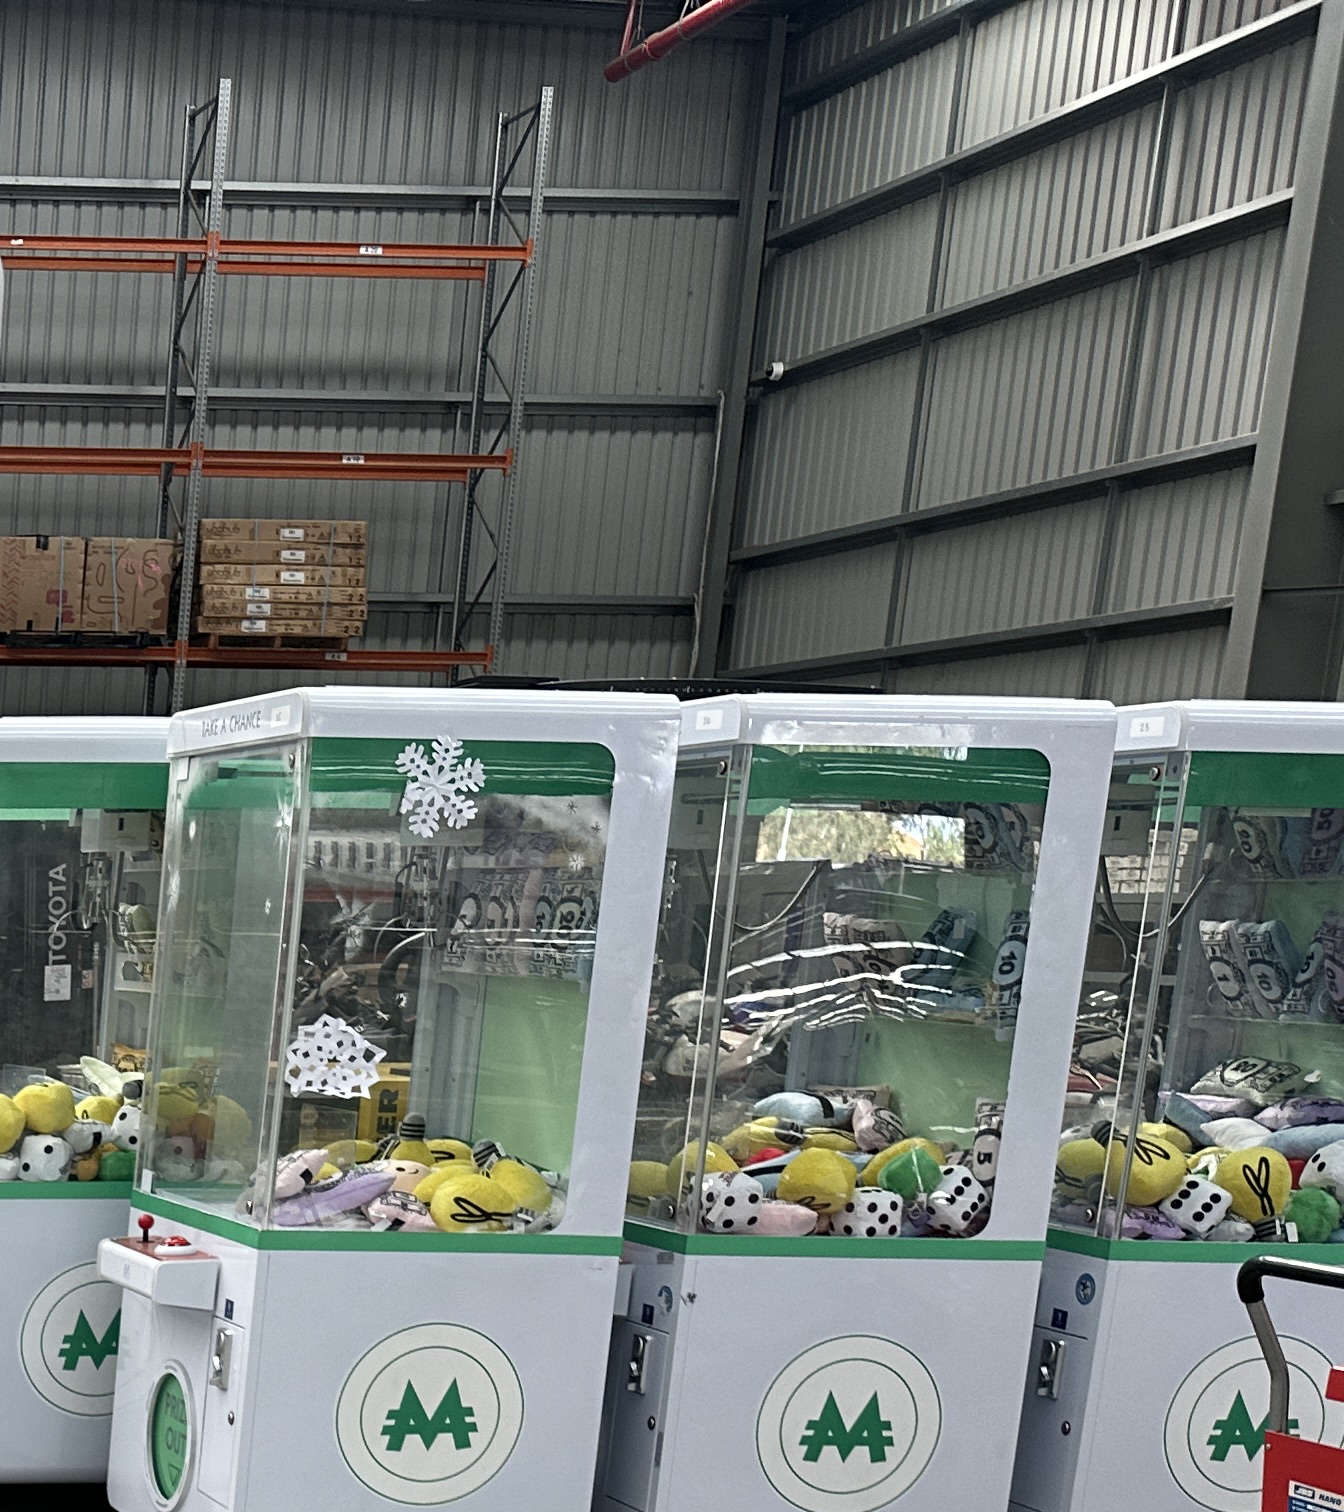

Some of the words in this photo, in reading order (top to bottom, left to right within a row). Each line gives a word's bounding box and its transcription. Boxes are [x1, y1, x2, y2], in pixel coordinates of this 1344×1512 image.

[229, 711, 262, 733] CHANCE
[48, 863, 67, 966] TOYOTA
[977, 1151, 993, 1165] 5
[164, 1391, 188, 1426] PRIZ
